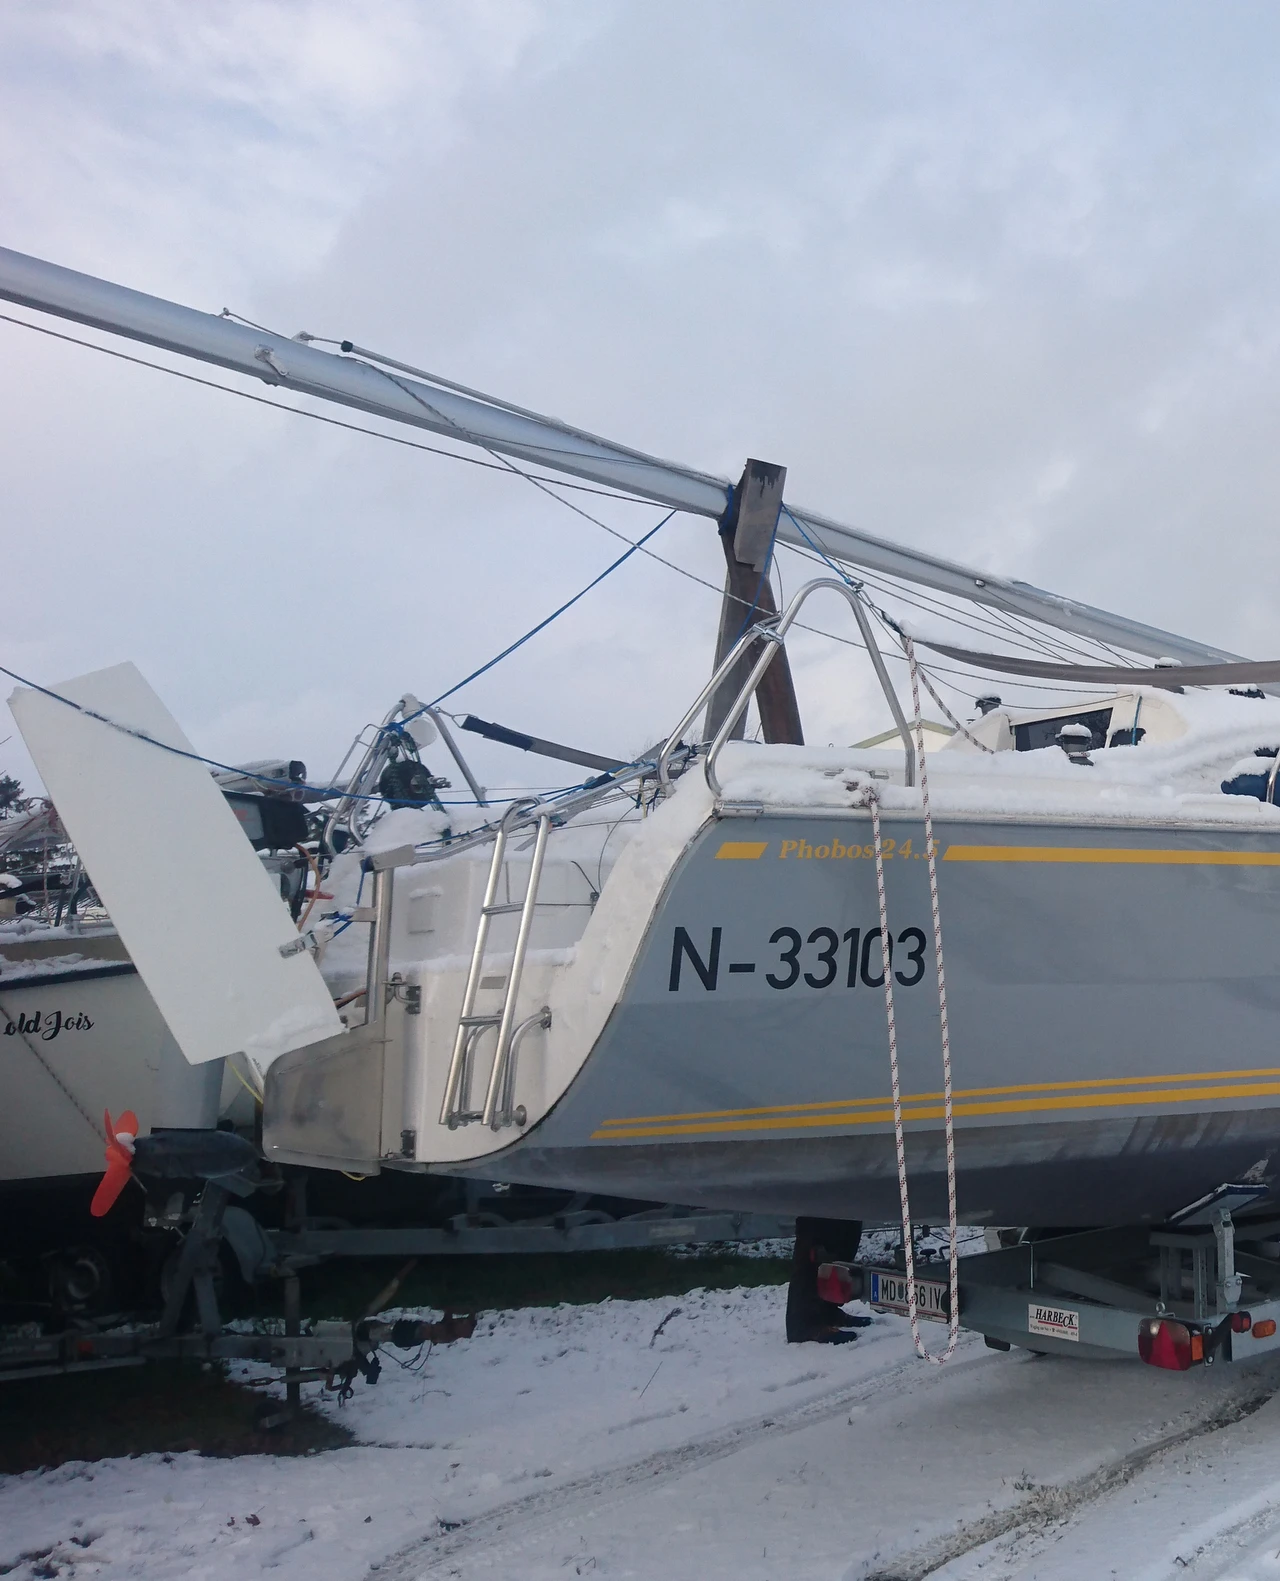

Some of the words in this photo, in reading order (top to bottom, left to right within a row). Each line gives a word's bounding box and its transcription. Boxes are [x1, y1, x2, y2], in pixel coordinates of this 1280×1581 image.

[779, 839, 876, 860] Phobos
[668, 926, 927, 992] N-33103
[41, 1010, 95, 1041] Jois
[881, 1279, 896, 1302] MD
[1035, 1308, 1075, 1328] HARBECK
